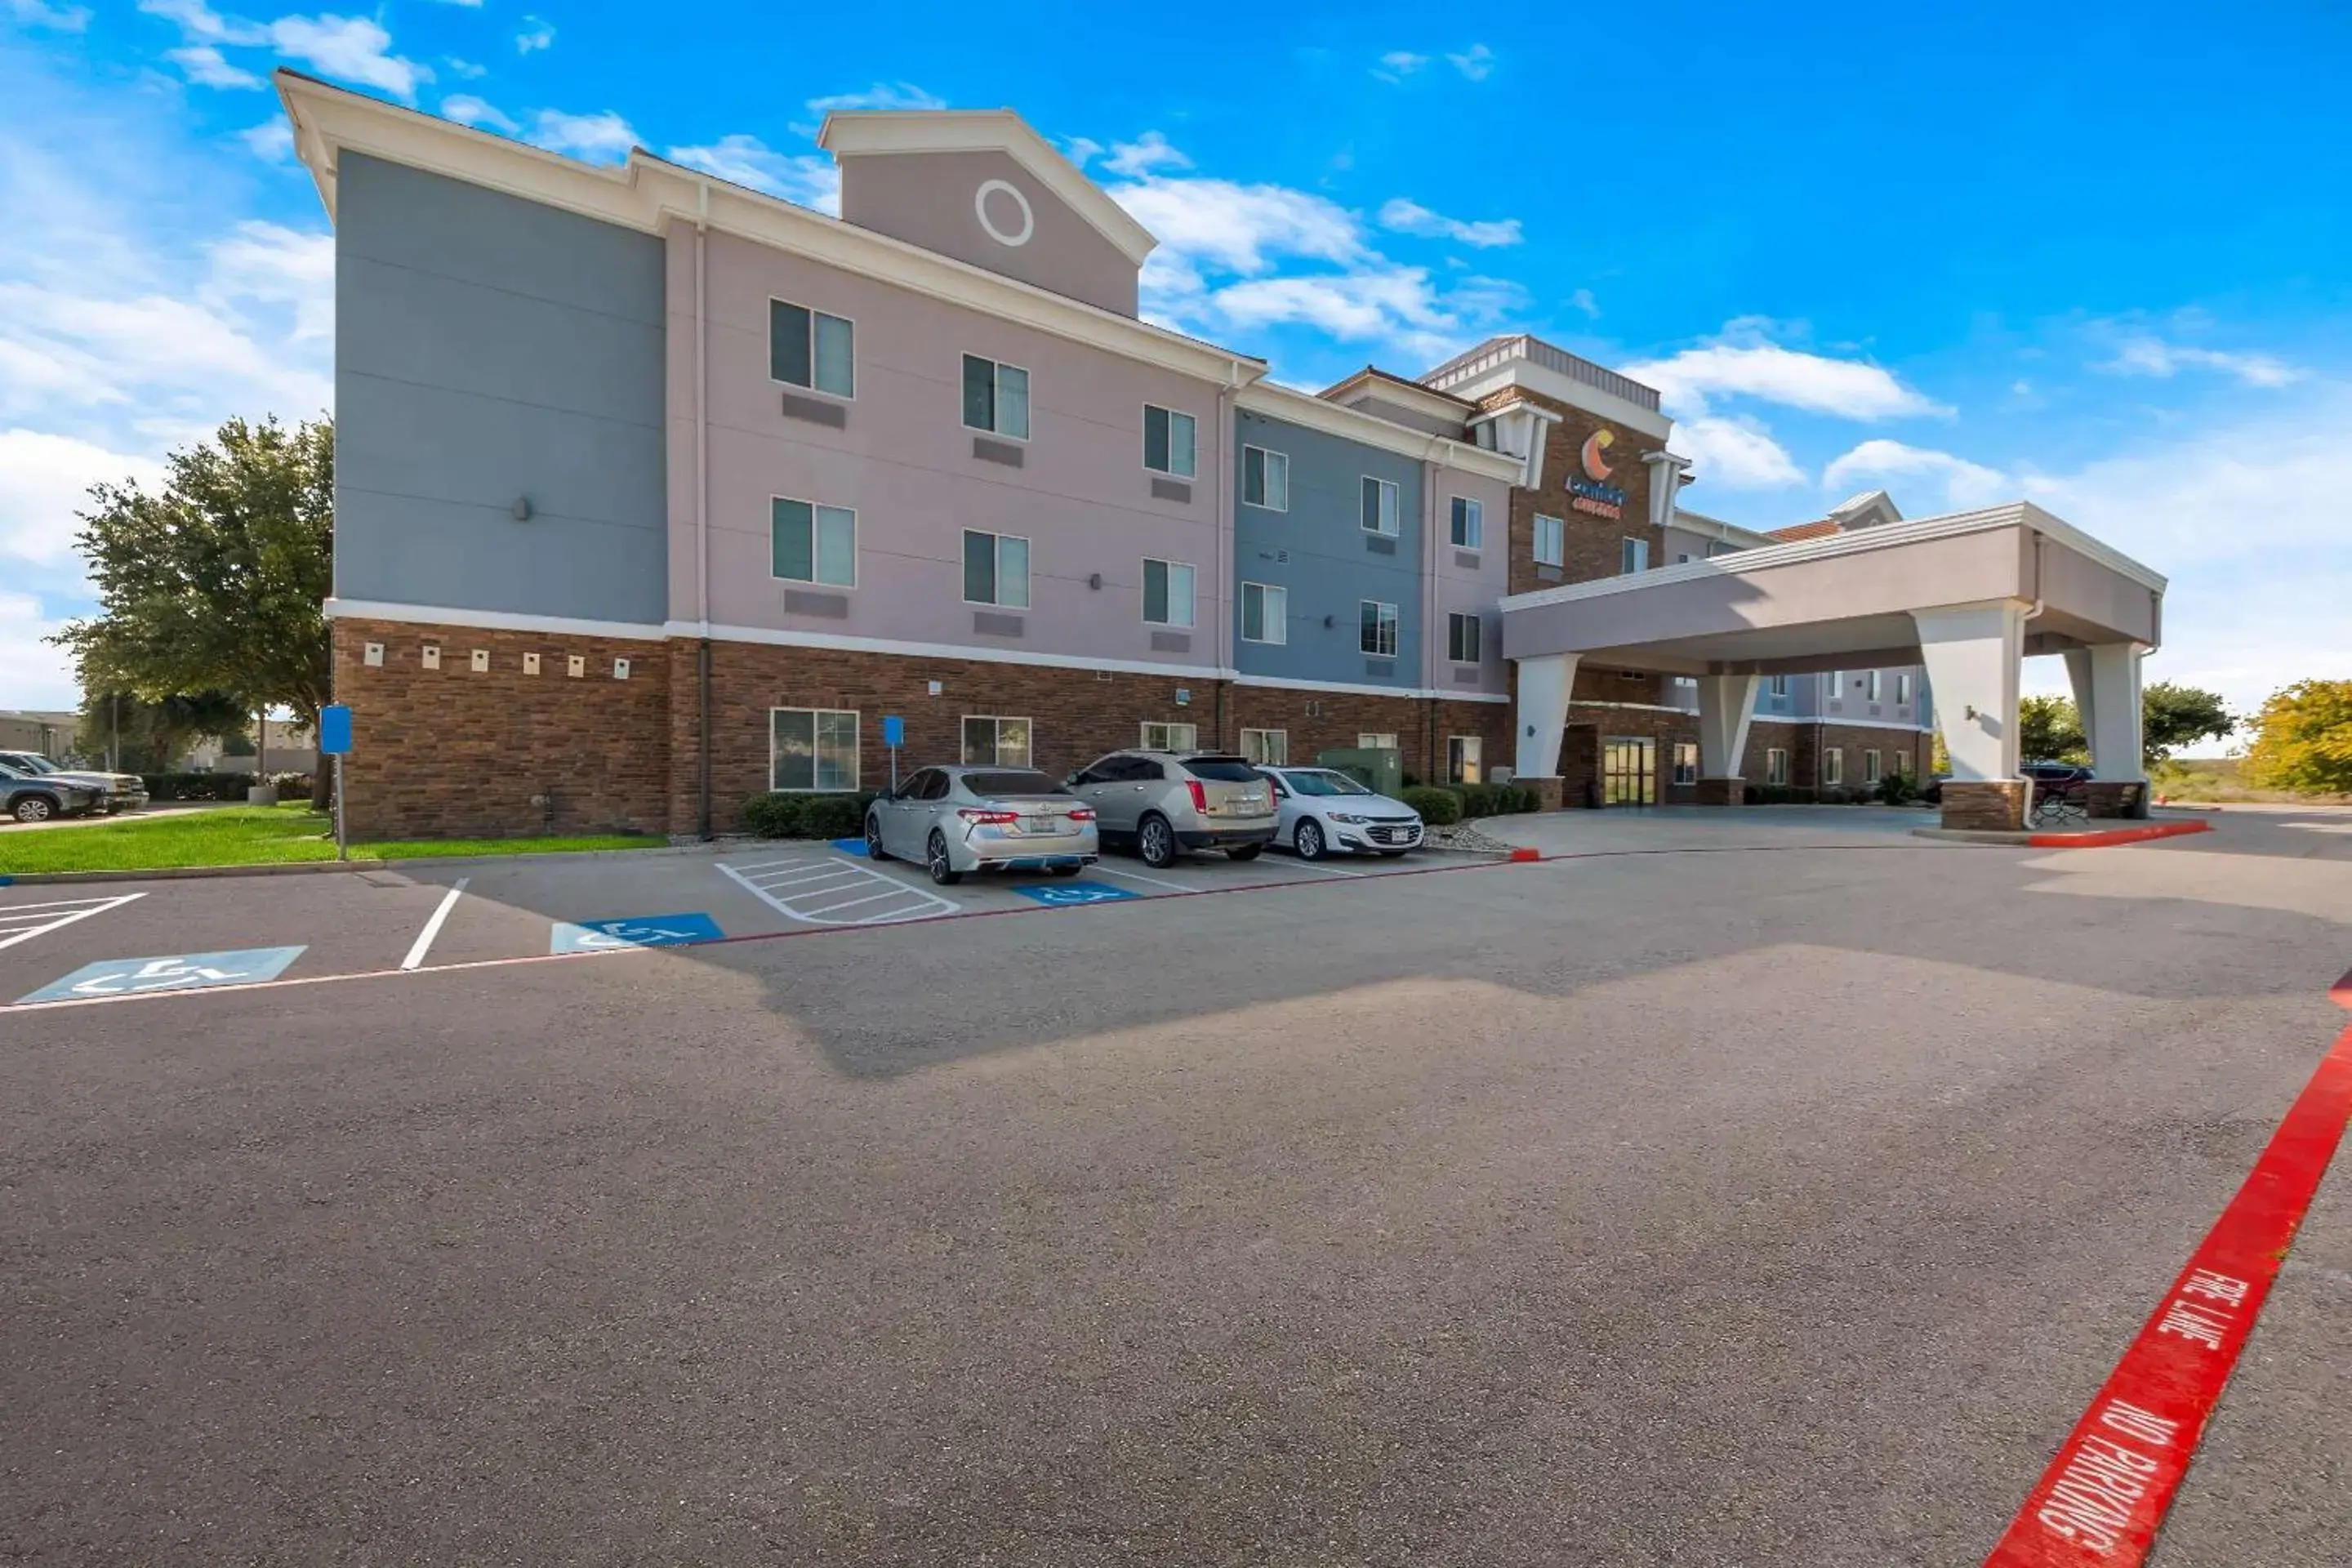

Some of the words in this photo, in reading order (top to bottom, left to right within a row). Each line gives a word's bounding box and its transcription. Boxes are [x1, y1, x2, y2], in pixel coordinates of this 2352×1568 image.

[2181, 1267, 2250, 1307] FIRE
[2158, 1298, 2235, 1350] LANE
[2100, 1398, 2180, 1446] NO
[2038, 1433, 2158, 1556] PARKING
